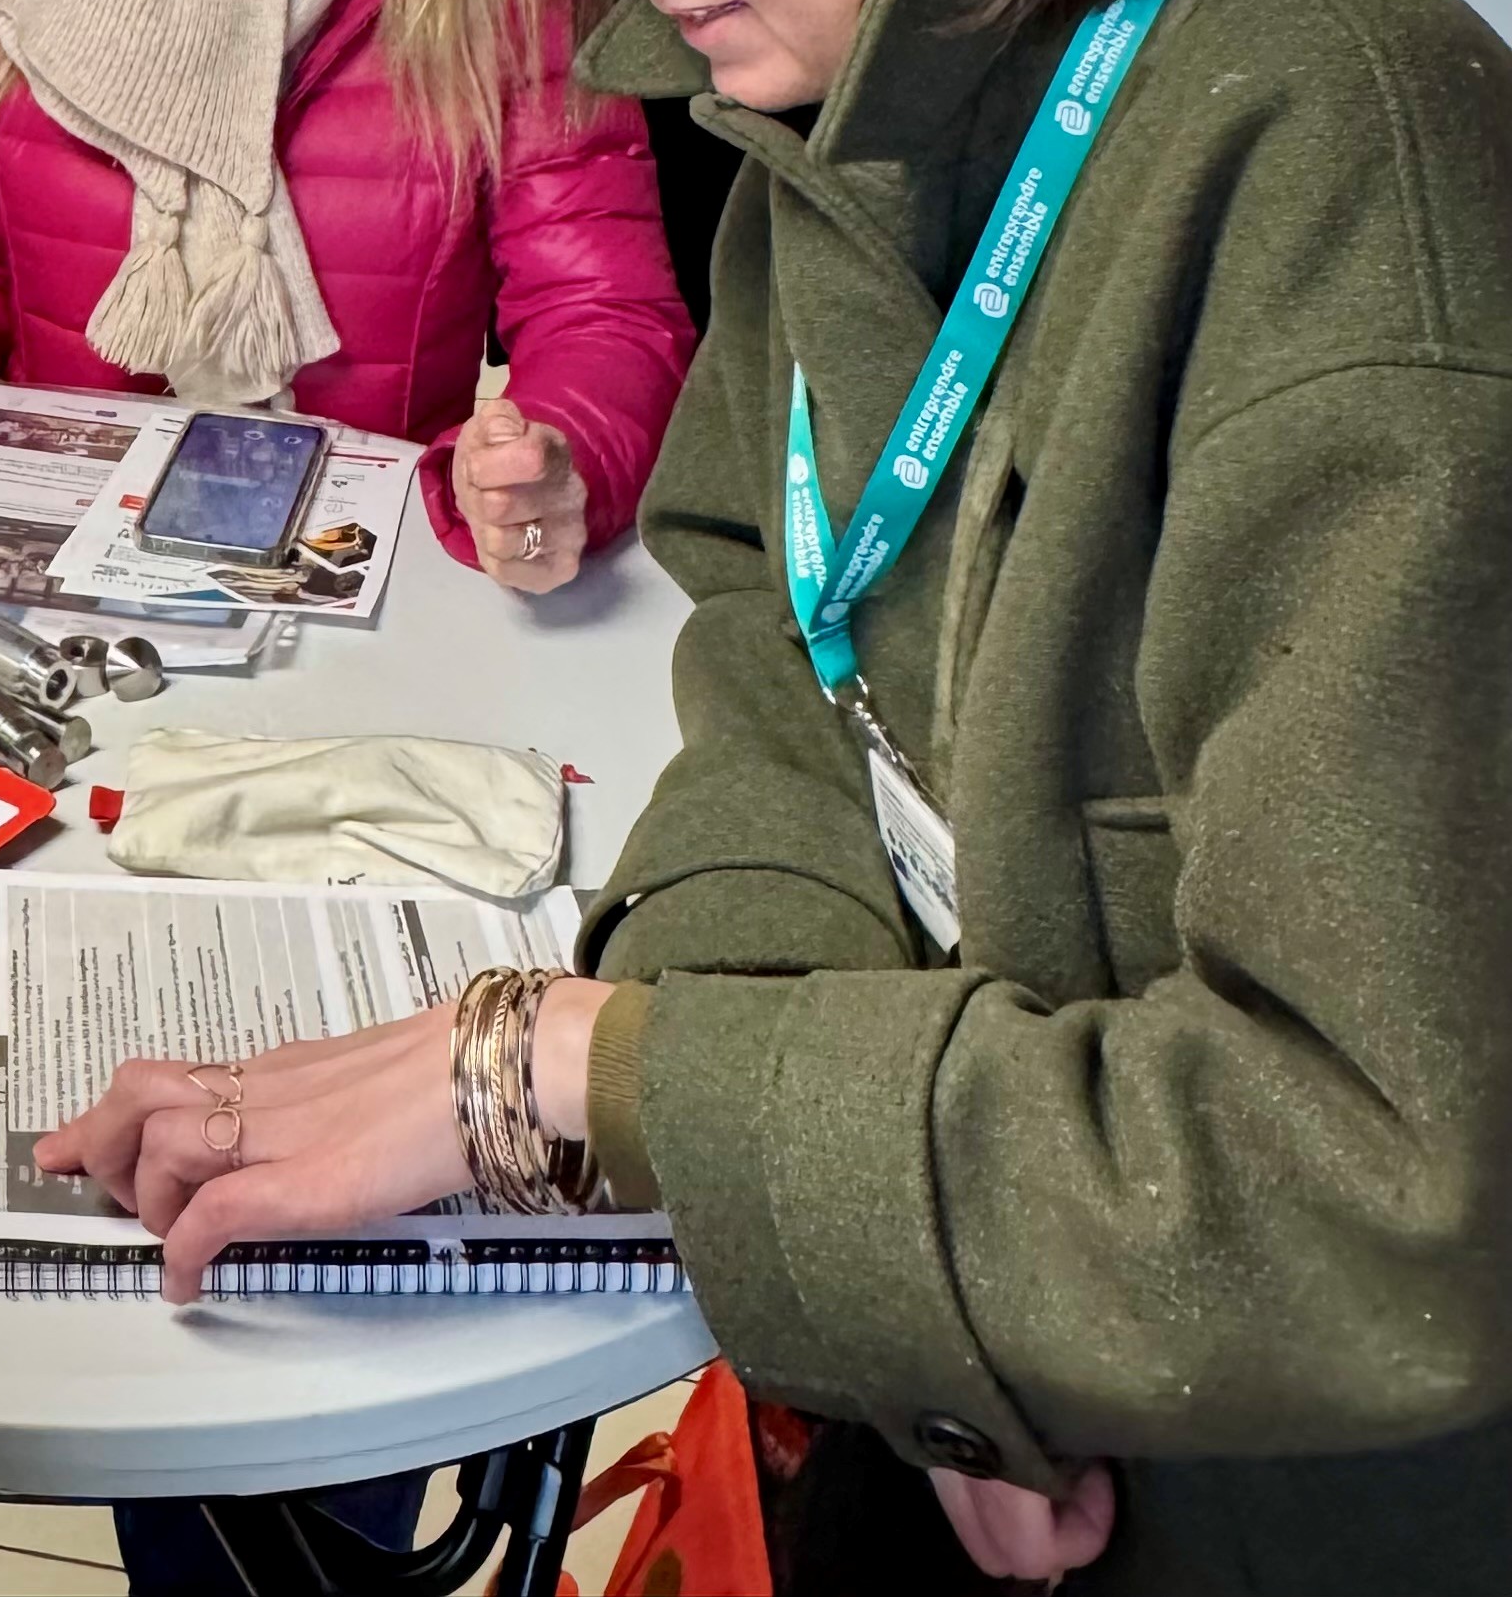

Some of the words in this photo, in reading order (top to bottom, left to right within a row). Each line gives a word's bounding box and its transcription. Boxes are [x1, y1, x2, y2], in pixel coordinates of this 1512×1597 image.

[1085, 19, 1136, 104] ensemble
[985, 167, 1043, 279] entreprendre
[1002, 201, 1049, 287] ensemble
[905, 349, 963, 452] entreprendre
[922, 382, 969, 461] ensemble
[792, 489, 811, 579] ensemble
